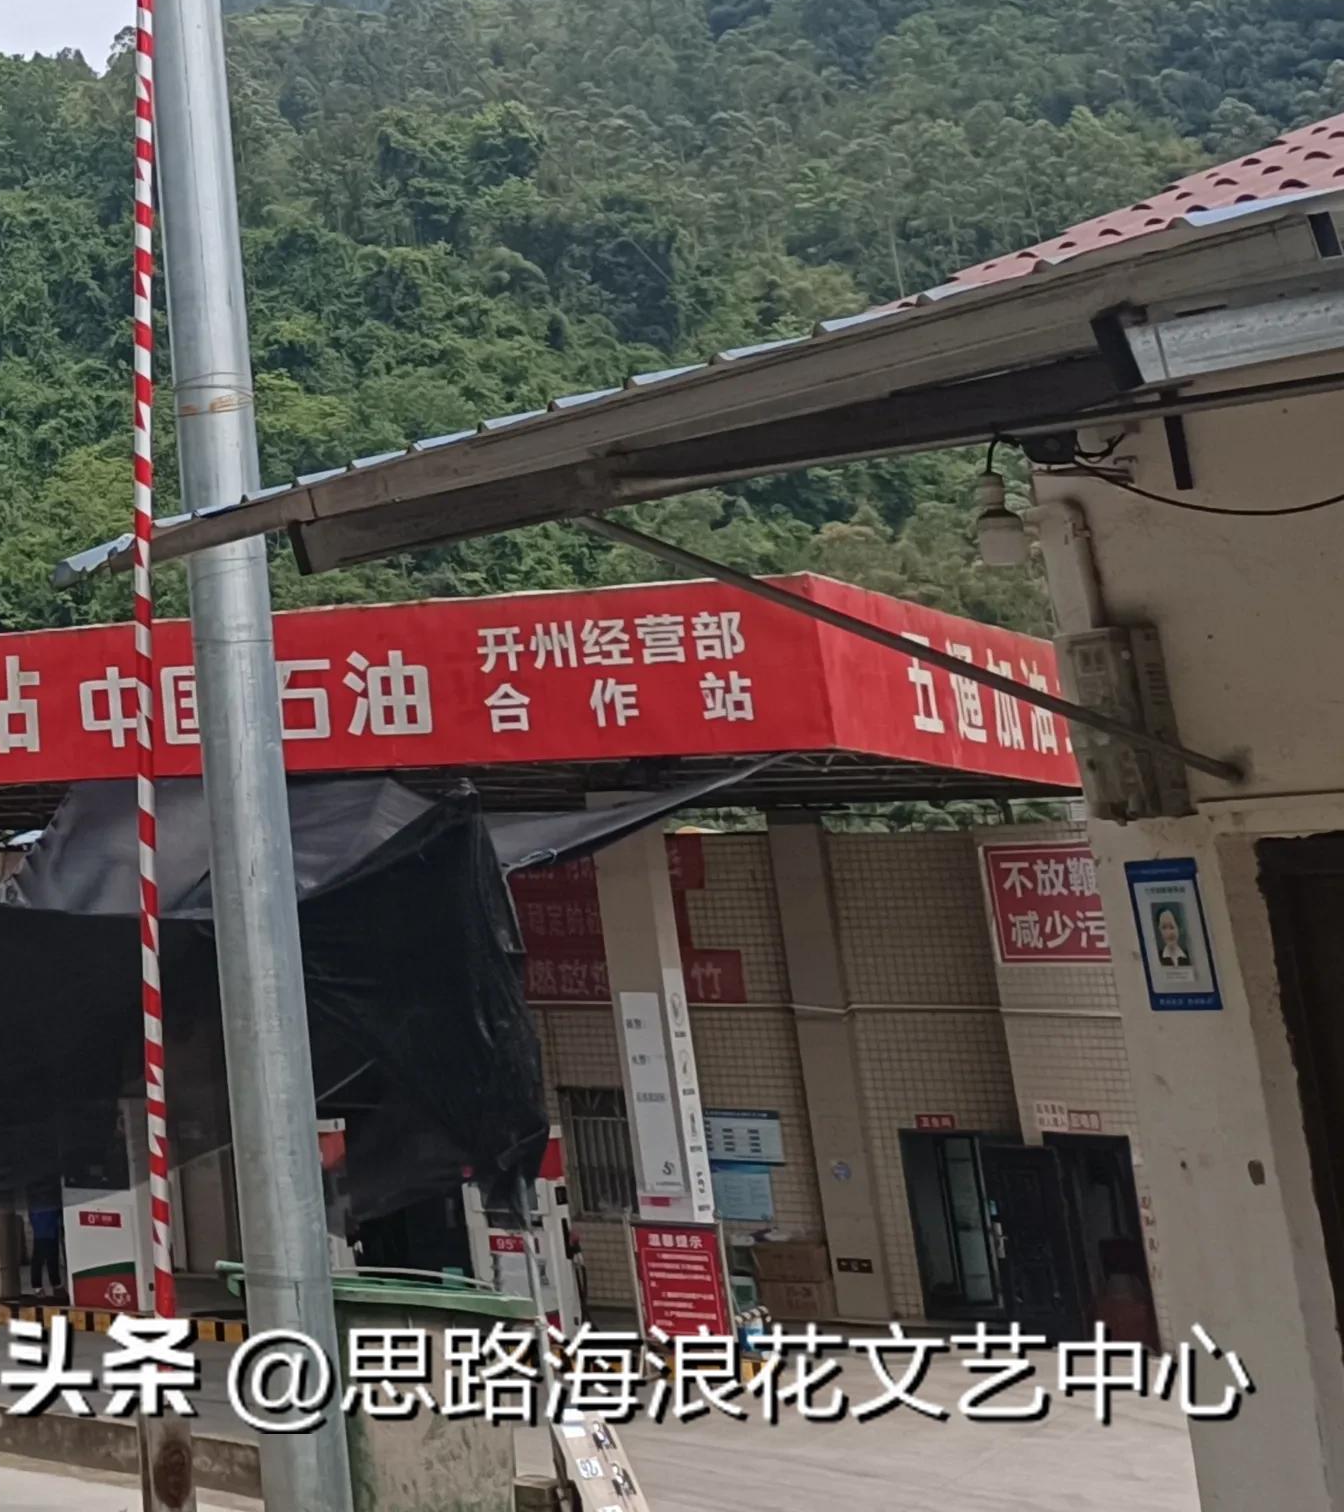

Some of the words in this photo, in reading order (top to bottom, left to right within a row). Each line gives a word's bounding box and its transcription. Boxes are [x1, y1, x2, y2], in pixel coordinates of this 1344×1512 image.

[477, 610, 746, 674] 开州经营部
[483, 672, 755, 733] 合作站
[901, 631, 1073, 756] 五通加油
[1007, 909, 1110, 950] 减少污
